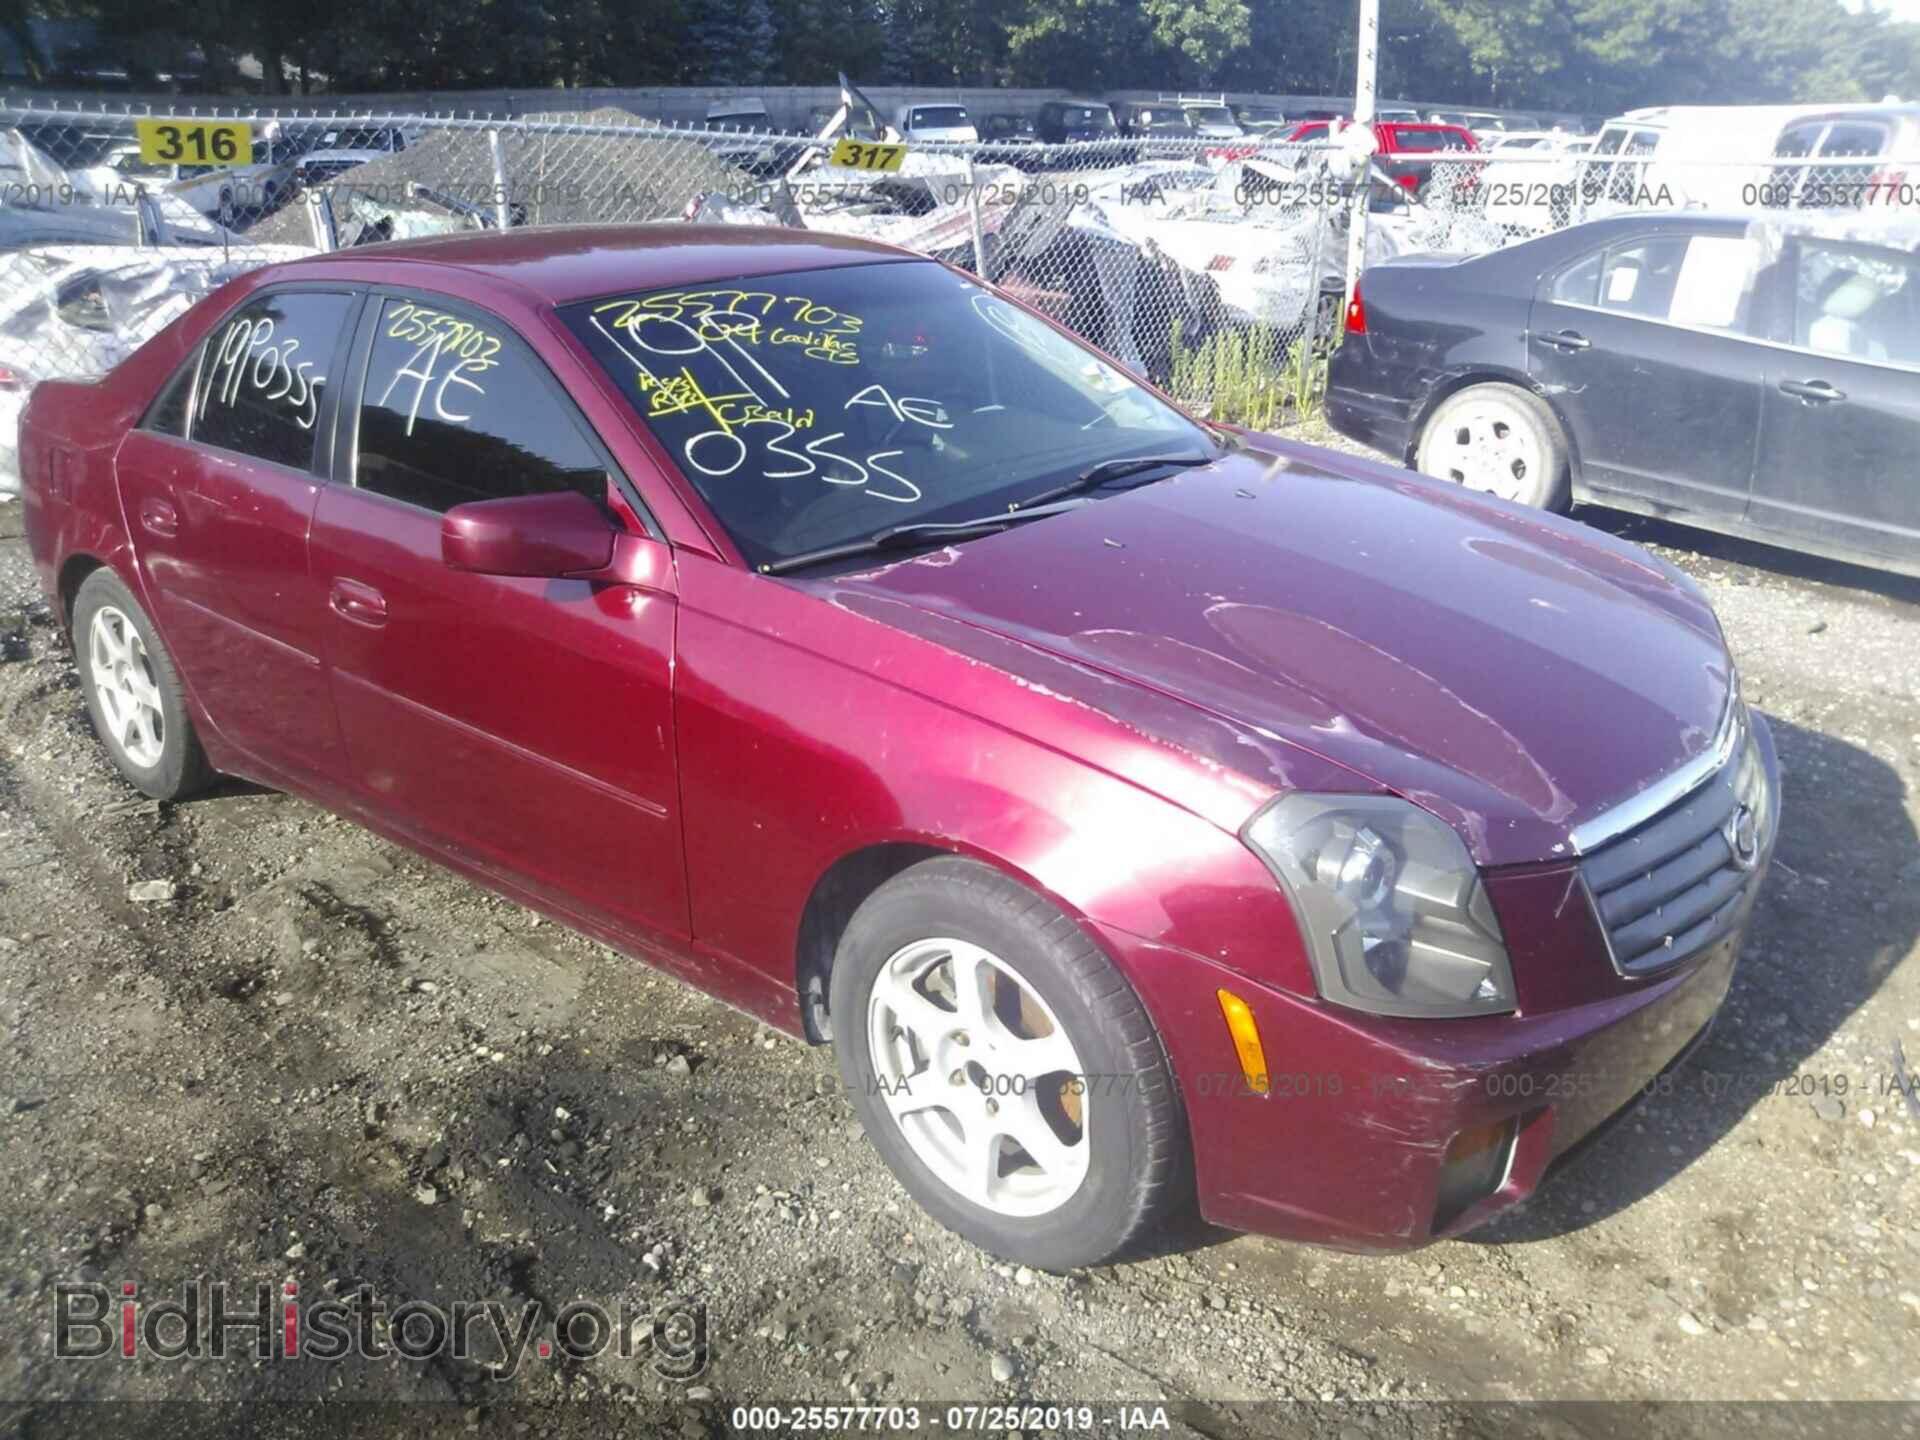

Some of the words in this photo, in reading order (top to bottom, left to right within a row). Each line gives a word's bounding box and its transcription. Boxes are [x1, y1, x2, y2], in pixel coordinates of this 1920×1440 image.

[157, 126, 236, 161] 316
[841, 144, 897, 170] 317
[595, 291, 864, 333] 25577703
[844, 384, 955, 428] AE
[685, 419, 921, 503] 0355
